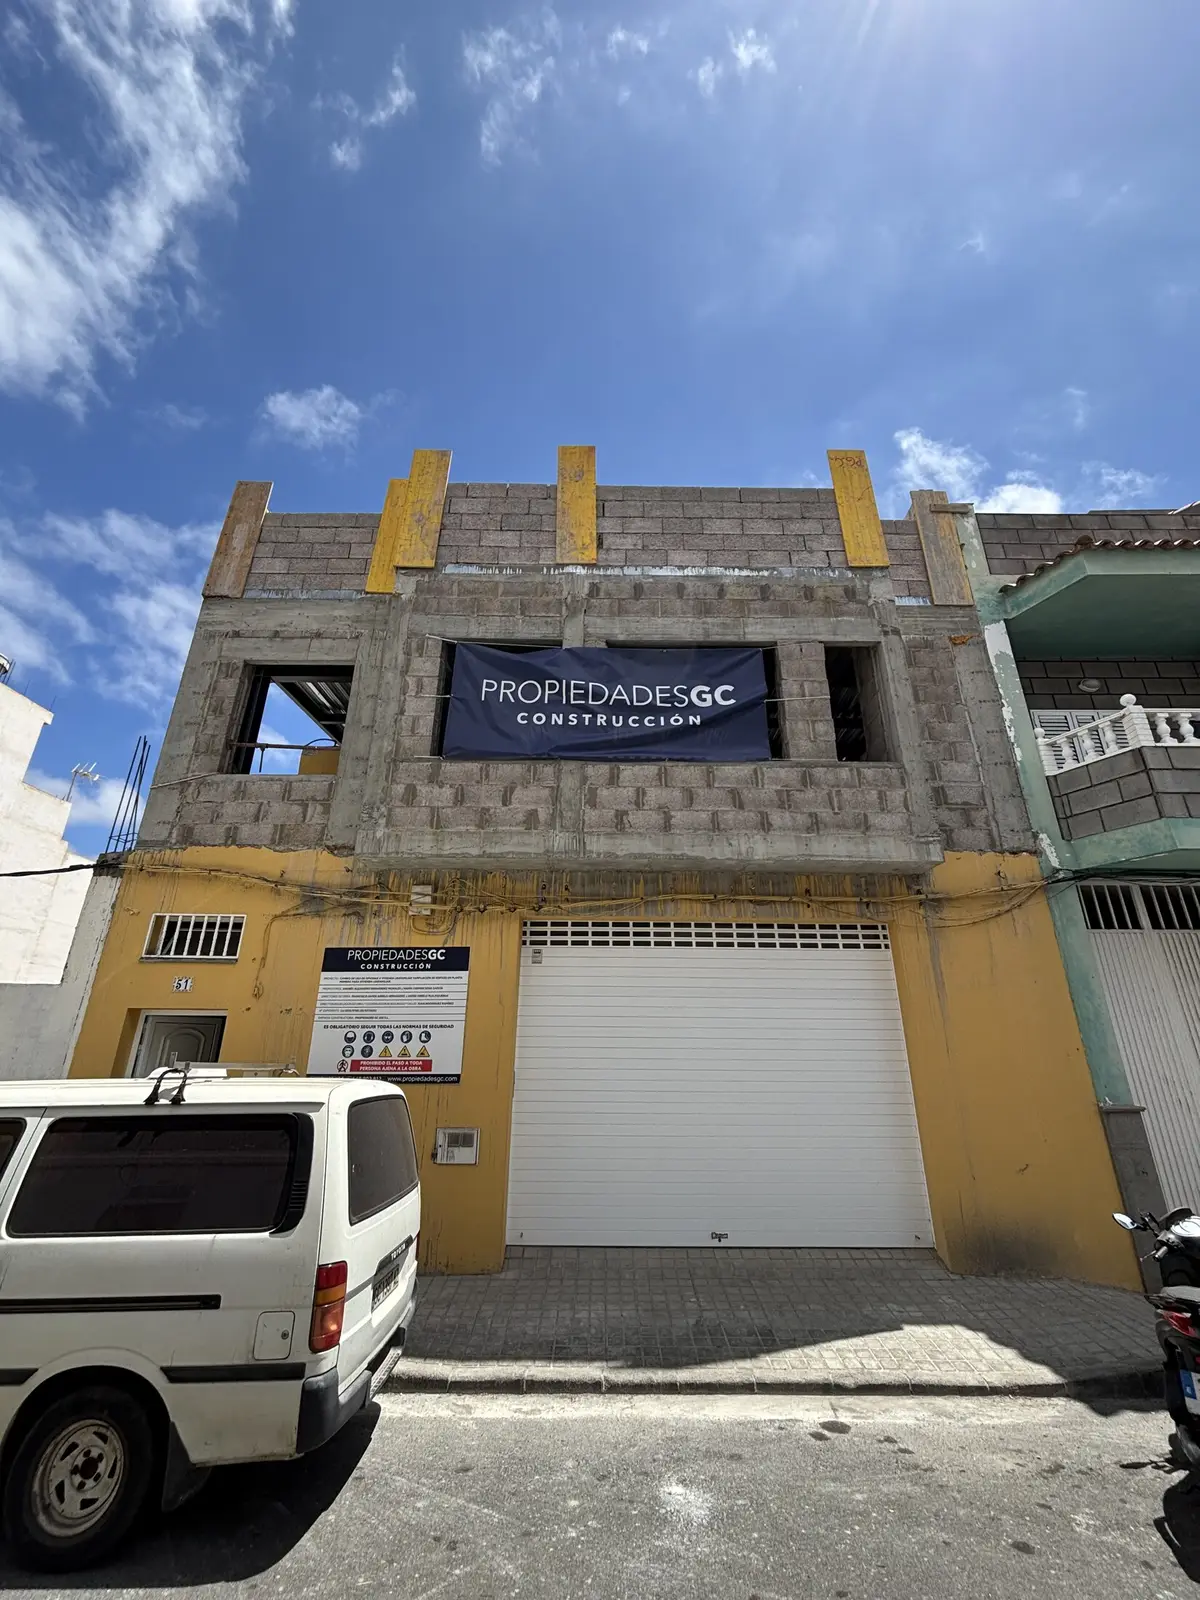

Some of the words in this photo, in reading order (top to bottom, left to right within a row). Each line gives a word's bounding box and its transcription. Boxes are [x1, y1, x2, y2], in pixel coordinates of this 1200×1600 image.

[481, 679, 736, 708] PROPIEDADESGC
[517, 711, 702, 727] CONSTRUCCIÓN
[347, 949, 446, 961] PROPIEDADESGC
[360, 962, 432, 970] CONSTRUCCIÓN
[176, 979, 189, 990] 51
